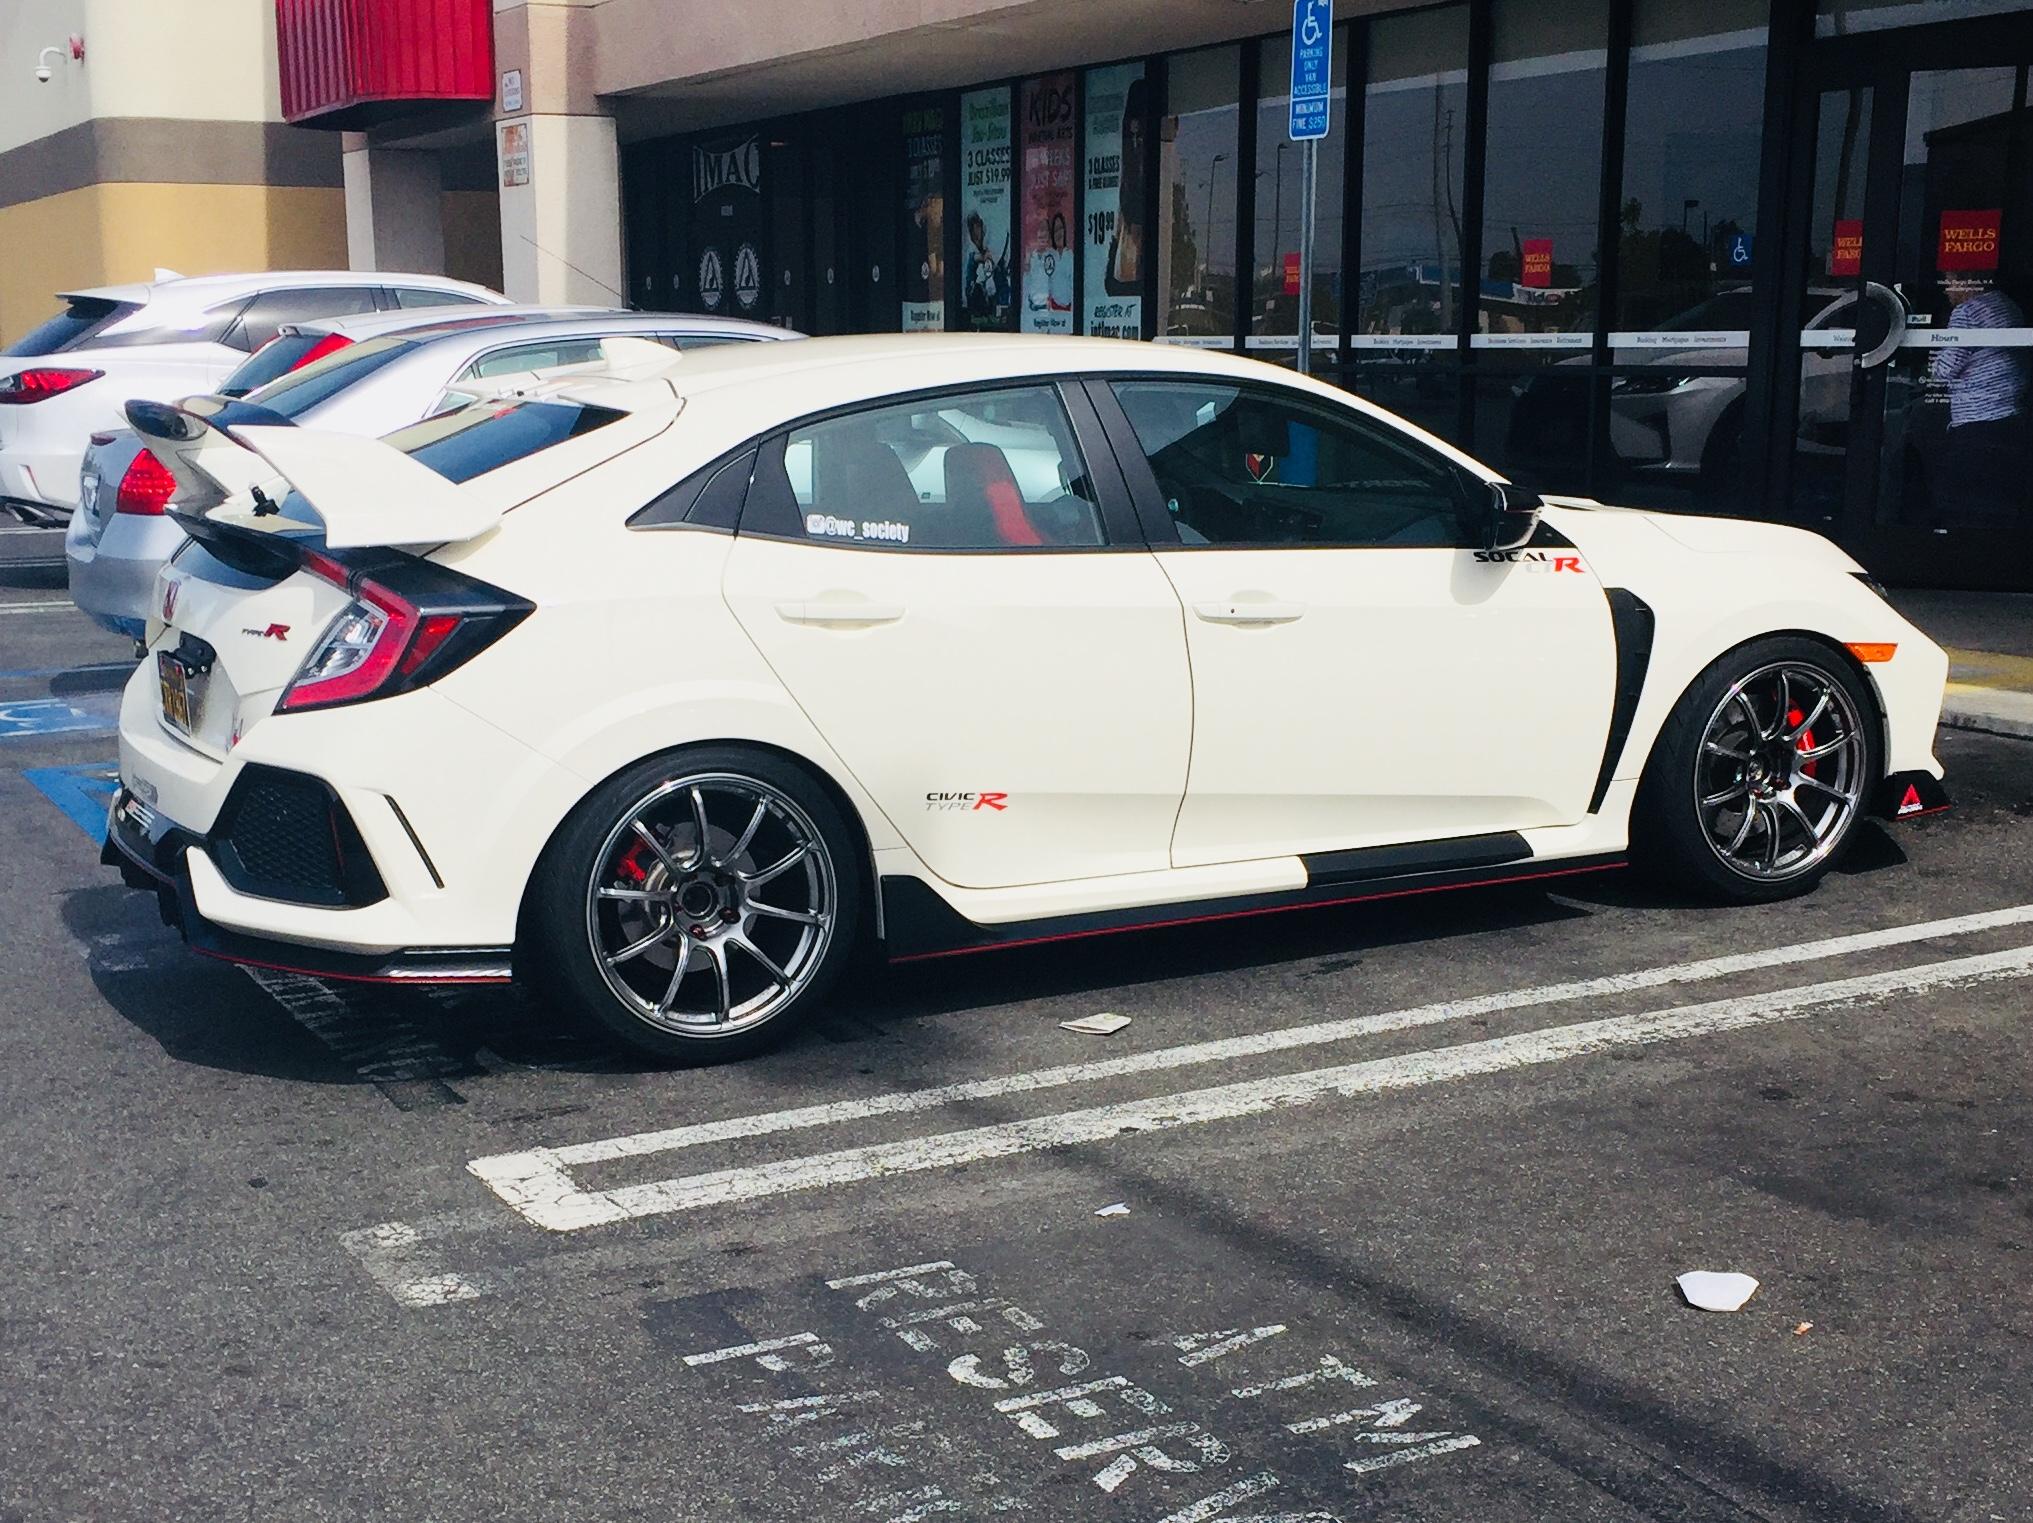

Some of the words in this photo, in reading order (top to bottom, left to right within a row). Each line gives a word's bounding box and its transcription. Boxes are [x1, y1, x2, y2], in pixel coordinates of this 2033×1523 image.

[1300, 47, 1323, 59] PARKING
[1304, 60, 1318, 71] ONLY
[1305, 72, 1317, 82] VAN
[1294, 83, 1327, 96] ACCESSIBLE
[1029, 86, 1072, 127] KIDS
[1295, 102, 1324, 114] MINIMUM
[1293, 118, 1306, 130] FINE
[1308, 116, 1326, 130] $250
[968, 151, 973, 169] 3
[975, 146, 1010, 167] CLASSES
[1094, 155, 1120, 174] CLASSES
[968, 170, 984, 186] JUST
[986, 166, 1010, 184] $19.99
[1944, 229, 1996, 240] WELLS
[1945, 241, 1995, 252] FARGO
[1525, 254, 1550, 262] WELLS
[1931, 333, 1959, 342] Hours
[826, 515, 910, 543] @wc_society
[1473, 551, 1552, 563] SOCAL
[264, 623, 291, 641] R
[926, 793, 976, 801] CIVIC
[926, 802, 972, 811] TYPE
[973, 792, 1009, 811] R
